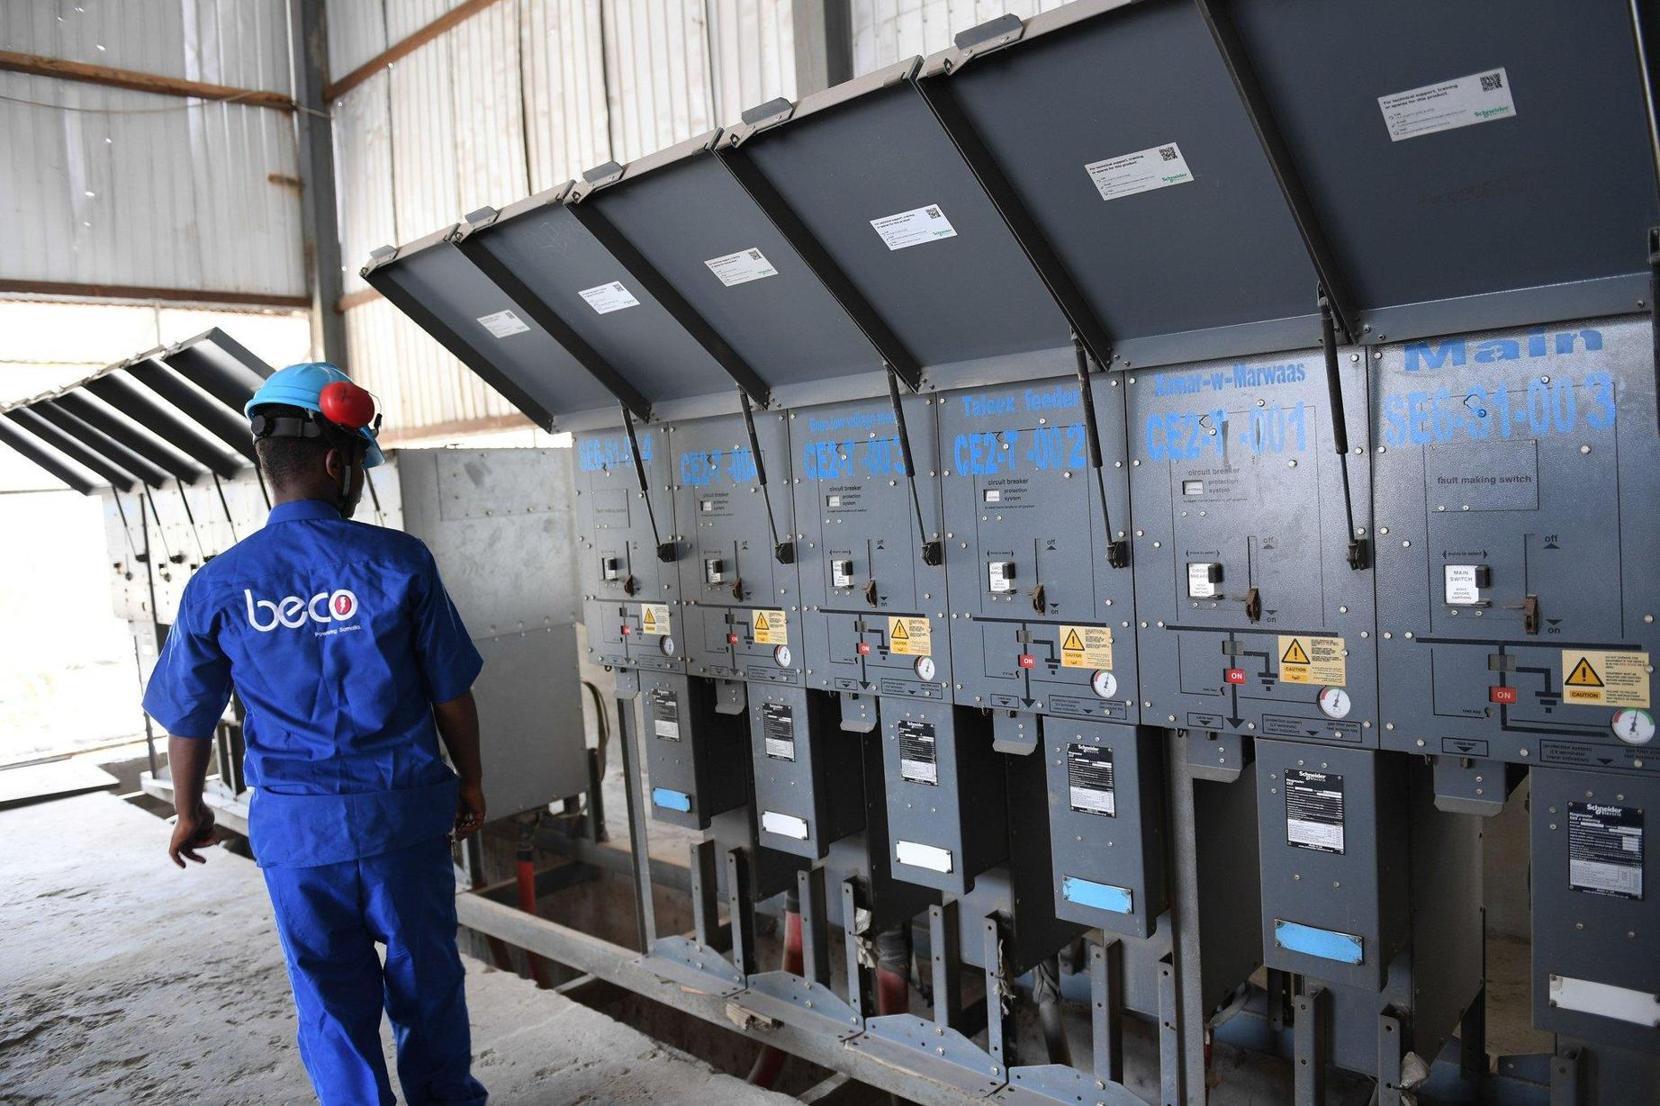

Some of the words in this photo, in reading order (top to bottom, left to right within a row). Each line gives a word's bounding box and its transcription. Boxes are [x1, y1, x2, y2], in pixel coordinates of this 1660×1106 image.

[1404, 328, 1603, 373] Main
[1437, 475, 1459, 484] fault
[1461, 475, 1496, 487] making
[1499, 474, 1532, 483] switch
[1544, 534, 1558, 542] off
[244, 589, 358, 632] beco
[1231, 672, 1243, 680] ON
[1497, 691, 1511, 699] ON
[1571, 691, 1599, 699] CAUTION
[1299, 771, 1326, 781] Schneider
[1587, 804, 1622, 815] Schneider
